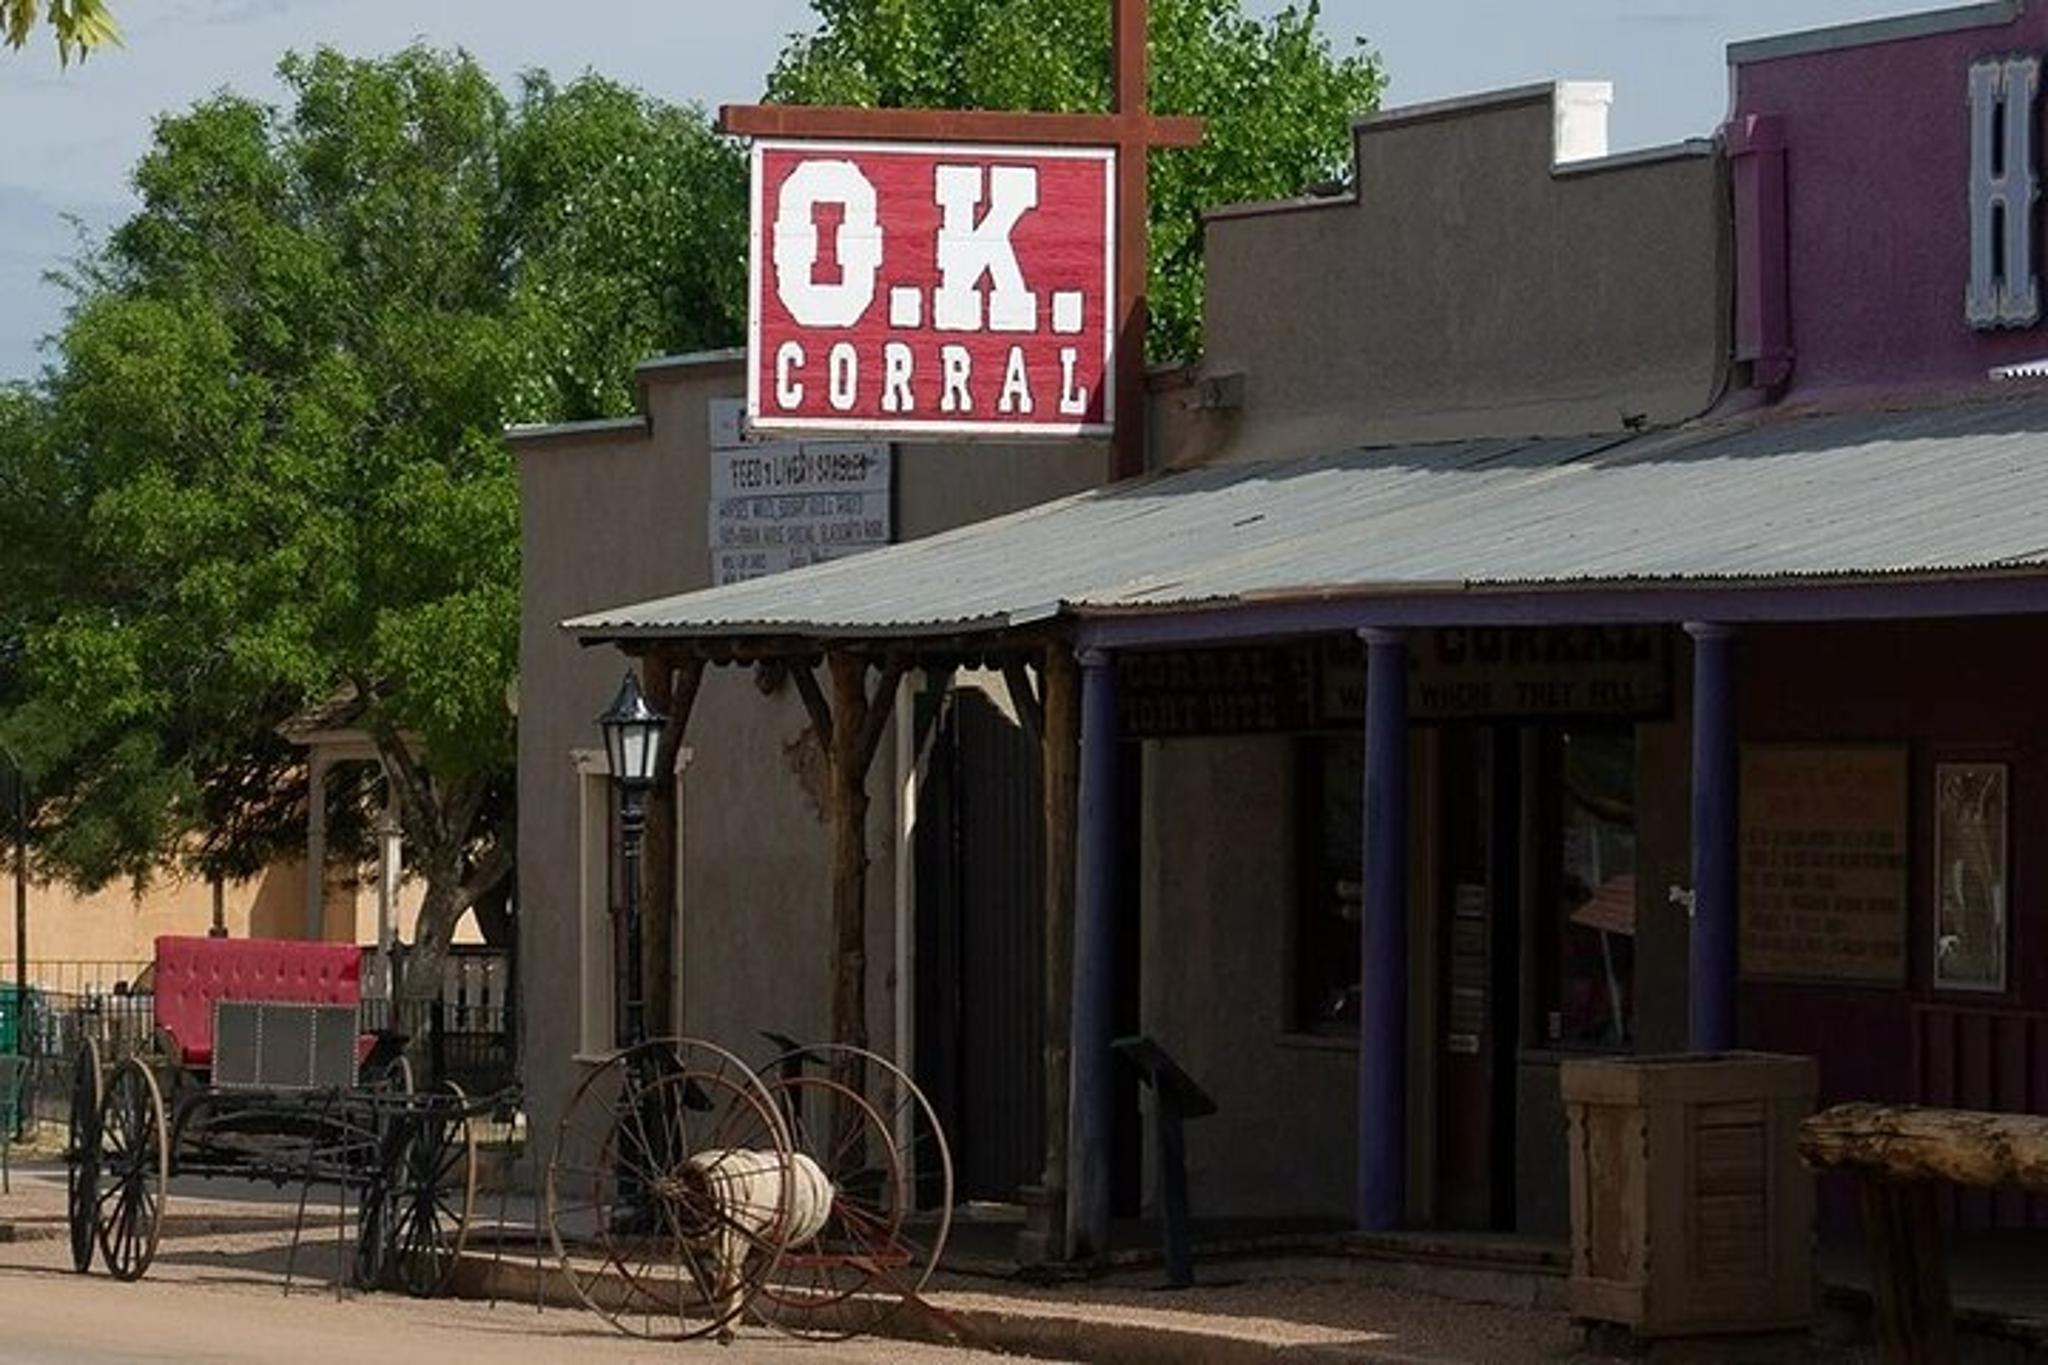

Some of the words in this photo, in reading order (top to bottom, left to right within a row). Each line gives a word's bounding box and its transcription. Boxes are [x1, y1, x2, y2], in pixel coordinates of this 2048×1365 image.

[773, 160, 1083, 333] O.K.
[775, 340, 1087, 416] CORRAL
[1515, 682, 1575, 708] THEY
